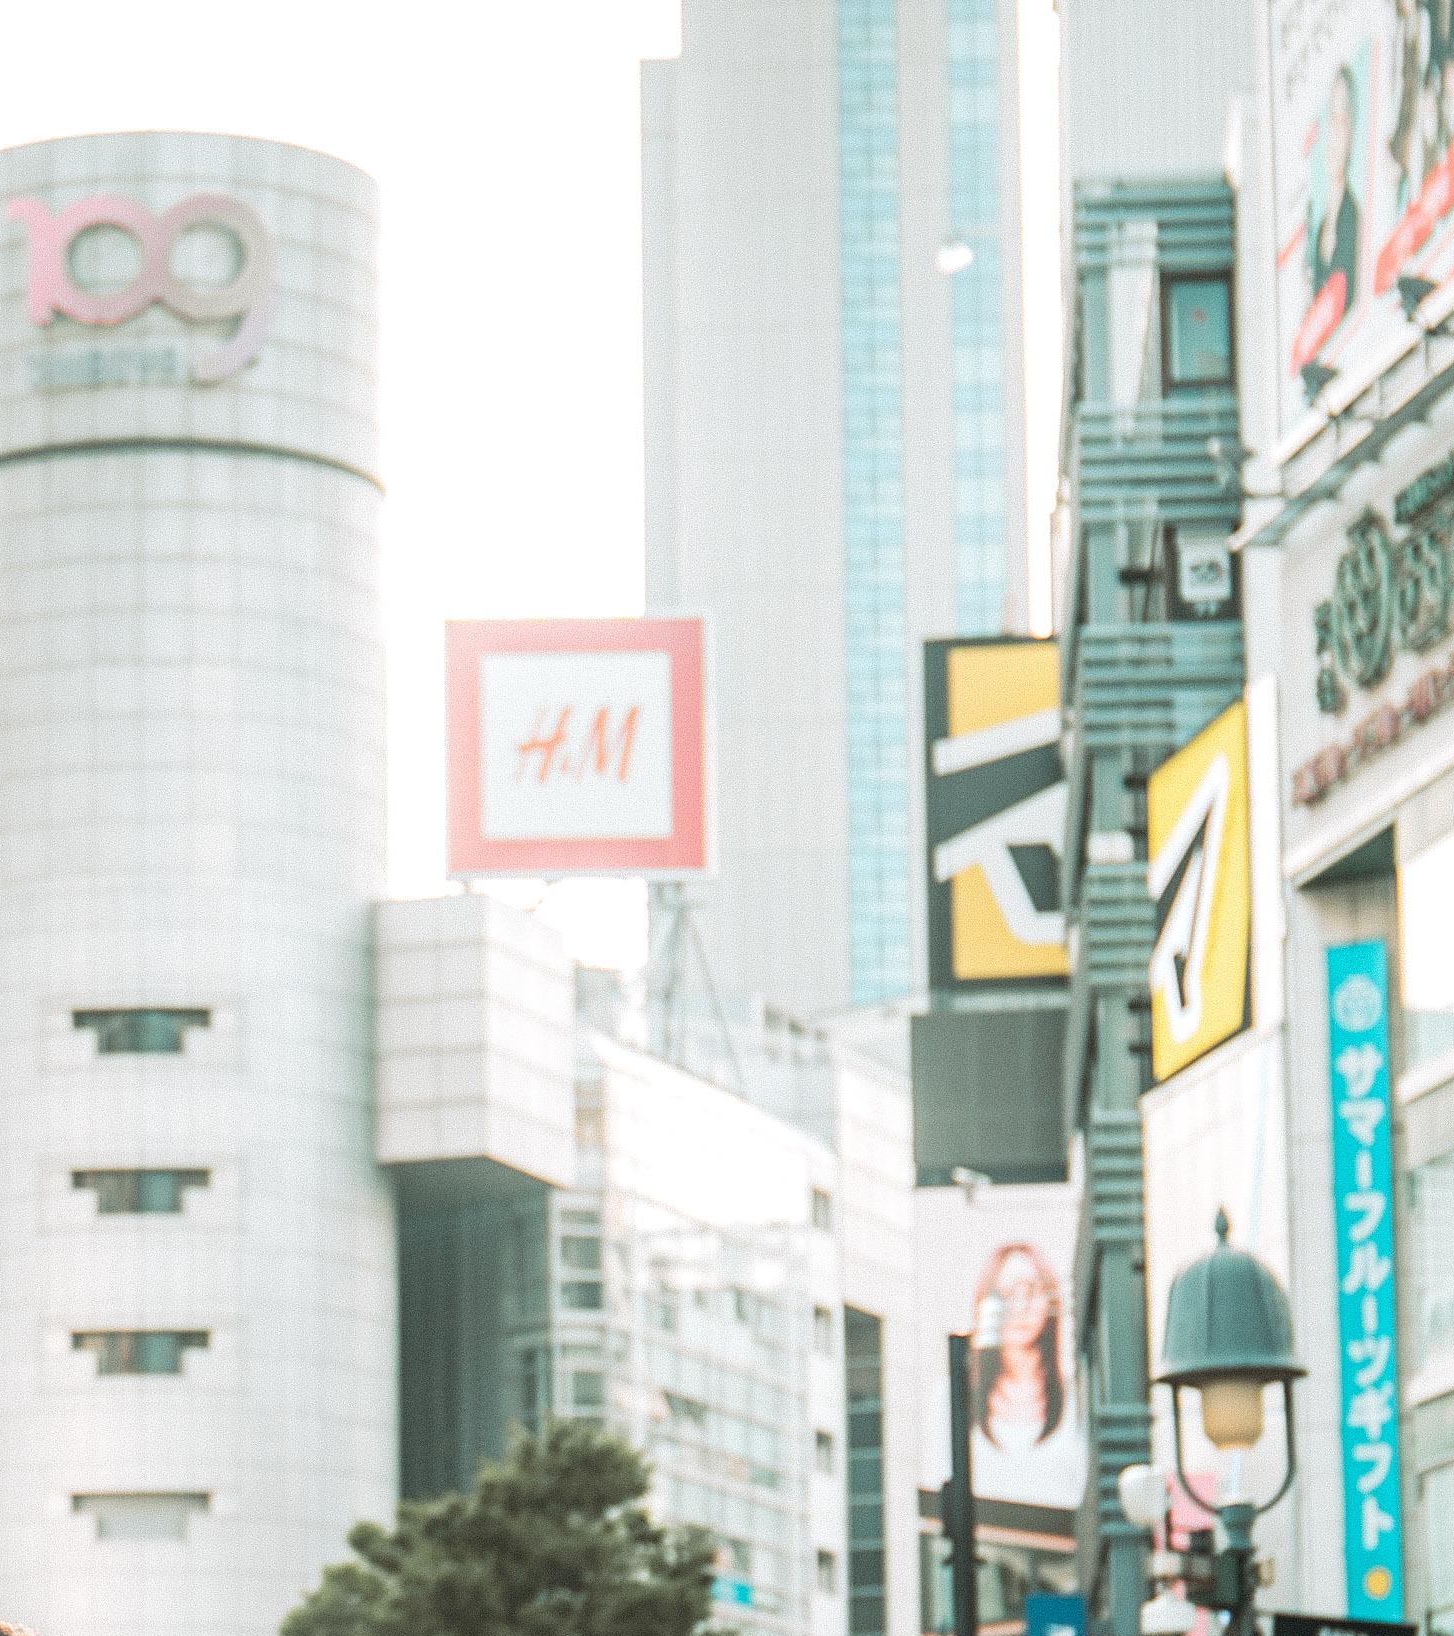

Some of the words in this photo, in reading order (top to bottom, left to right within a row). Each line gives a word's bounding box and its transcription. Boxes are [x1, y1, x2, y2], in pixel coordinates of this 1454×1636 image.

[5, 192, 274, 386] 109
[516, 705, 640, 783] H&M
[1333, 1045, 1396, 1550] サマーフルーツギフト
